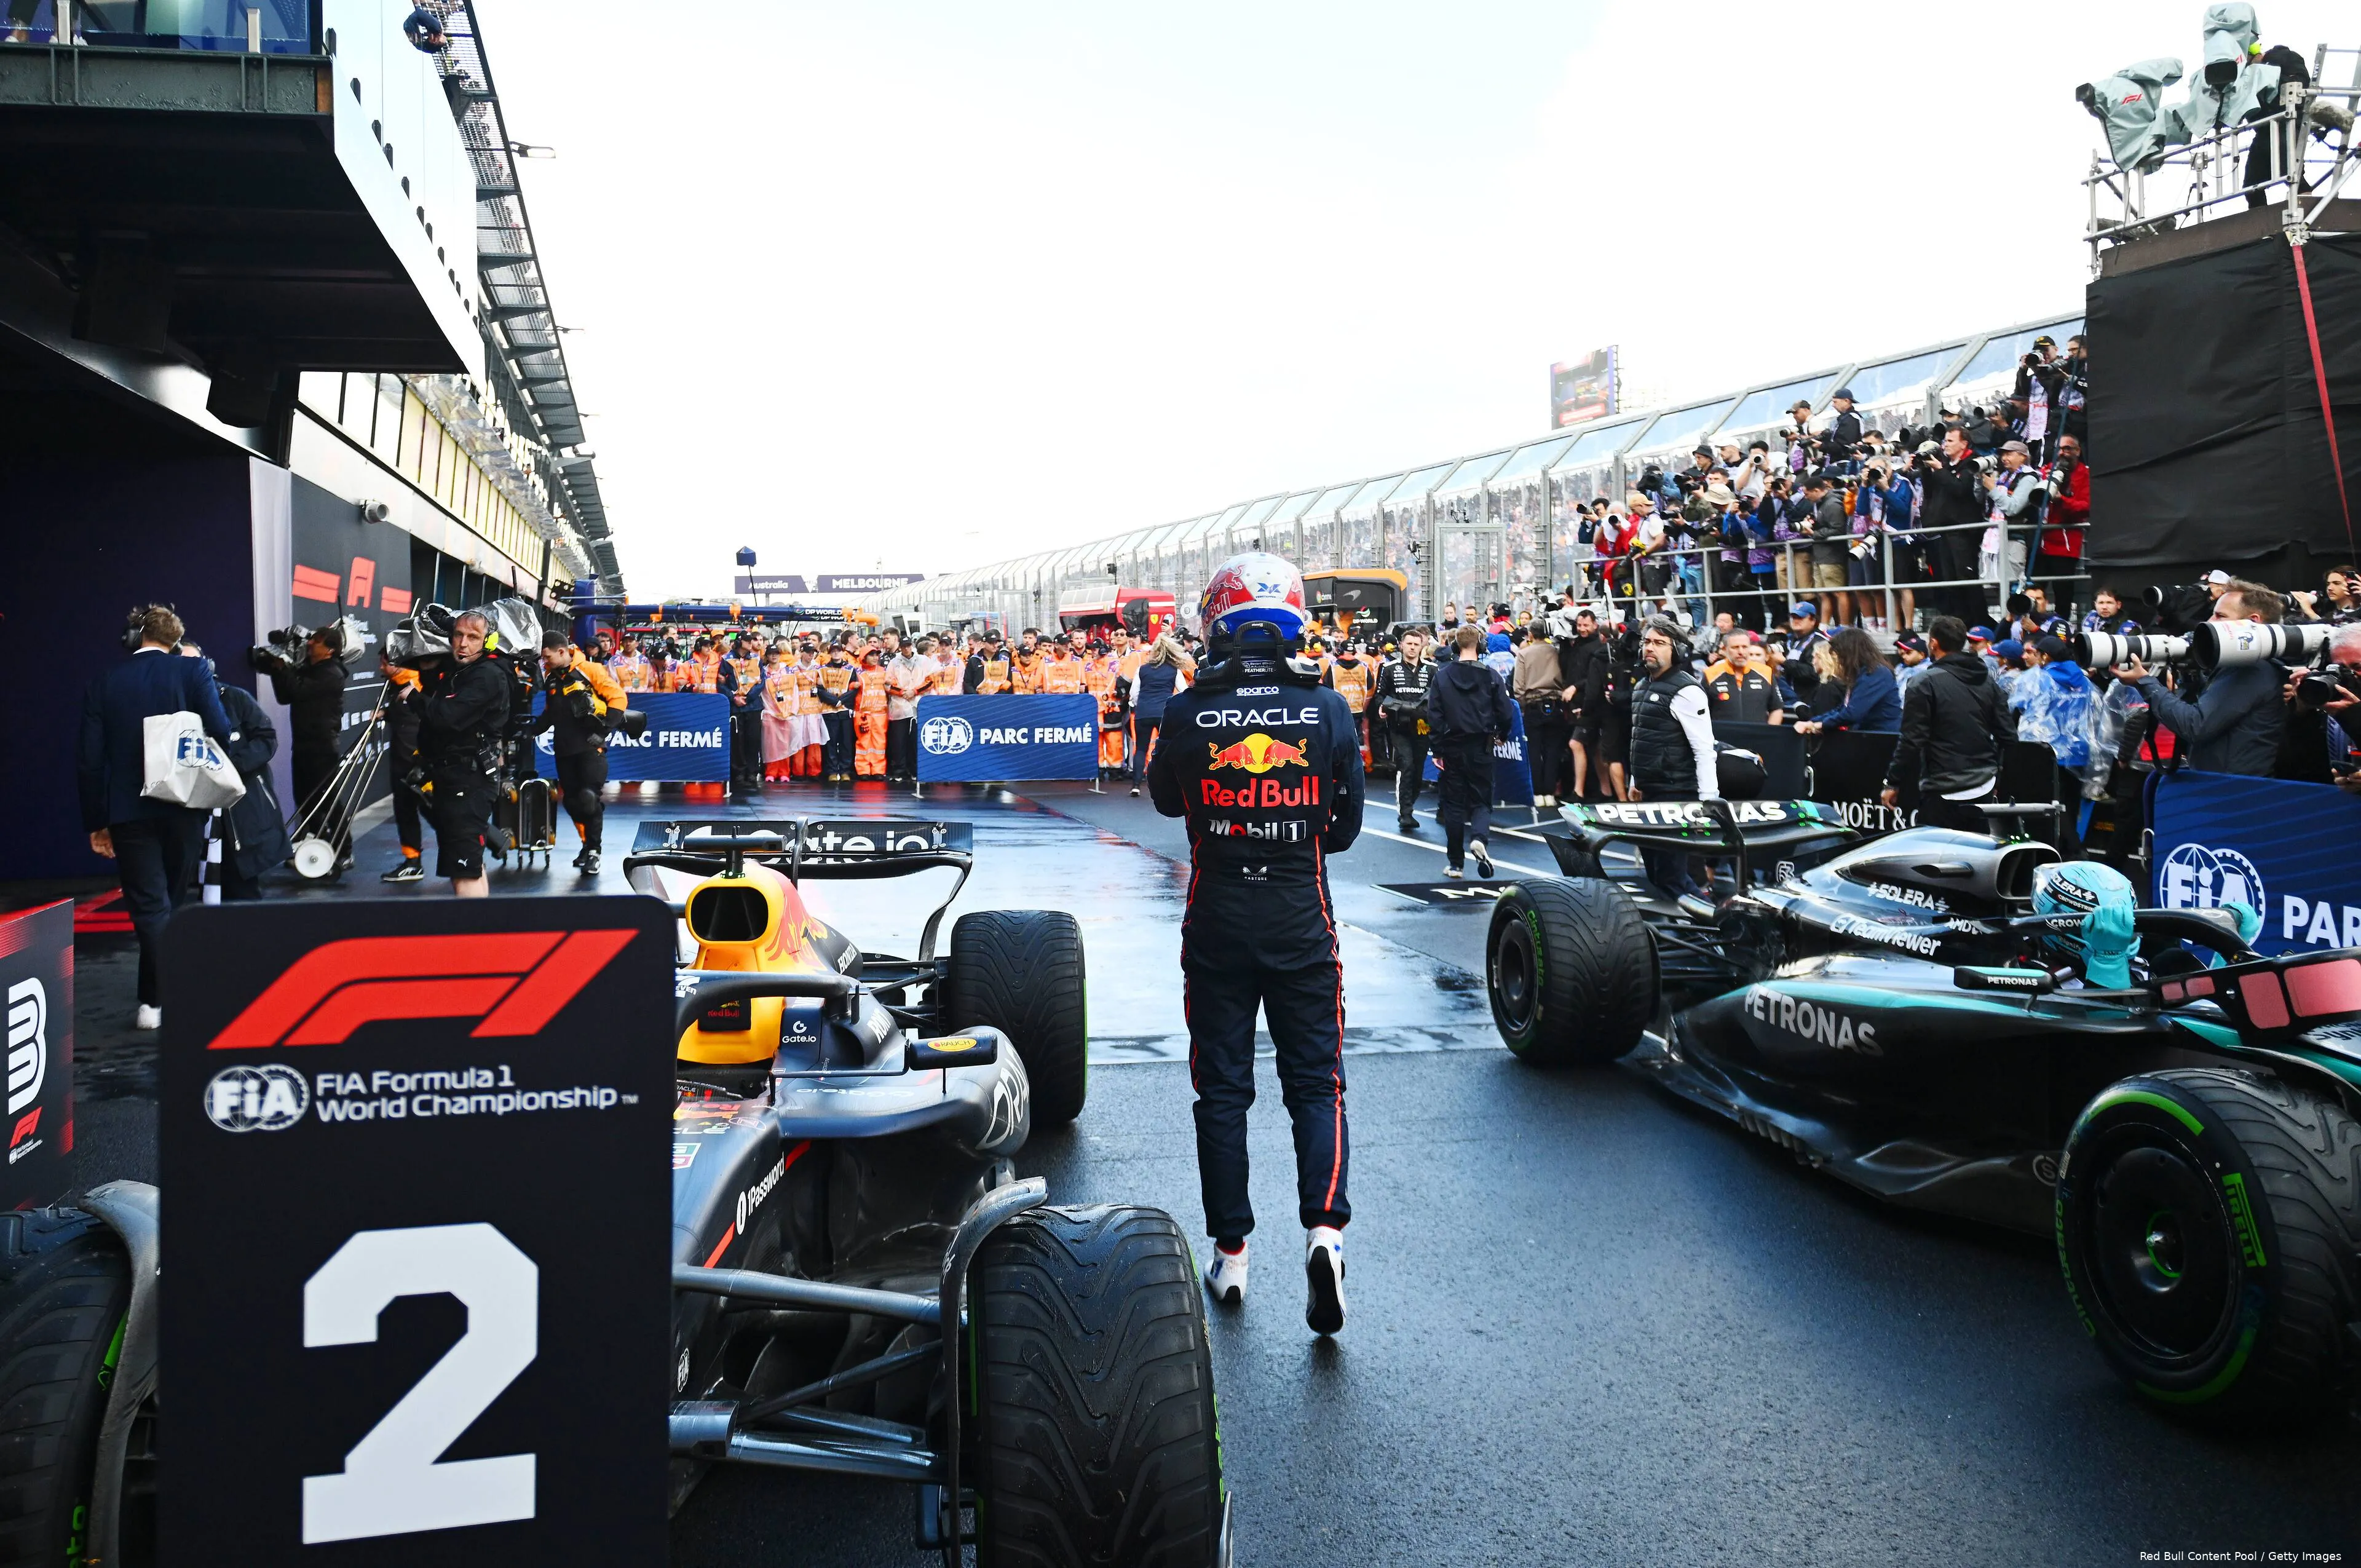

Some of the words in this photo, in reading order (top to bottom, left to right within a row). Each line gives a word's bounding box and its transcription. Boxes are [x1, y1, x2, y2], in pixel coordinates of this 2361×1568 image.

[748, 580, 789, 589] Australia
[832, 577, 909, 589] MELBOURNE
[1236, 686, 1279, 697] sparco
[1196, 707, 1320, 728] ORACLE
[658, 726, 722, 748] FERMÉ
[979, 727, 1029, 745] PARC
[1034, 723, 1093, 743] FERMÉ
[1201, 778, 1257, 808] Red
[1261, 776, 1319, 808] Bull
[1833, 798, 1888, 831] MOËT
[1892, 807, 1907, 831] &
[1209, 819, 1278, 841] Mobil
[1877, 883, 1935, 911] SOLERA
[1846, 917, 1942, 956] TeamViewer
[1987, 976, 2038, 987] PETRONAS
[1744, 983, 1884, 1057] PETRONAS
[8, 976, 47, 1115] 3
[781, 1035, 817, 1043] Gate.io
[940, 1039, 971, 1048] RAUCH
[315, 1073, 368, 1096] FIA
[371, 1066, 493, 1094] Formula
[497, 1064, 515, 1088] 1
[317, 1095, 407, 1123] World
[410, 1085, 618, 1117] Championship
[747, 1150, 785, 1217] 1Password
[2221, 1172, 2268, 1268] PIRELLI
[302, 1221, 539, 1545] 2
